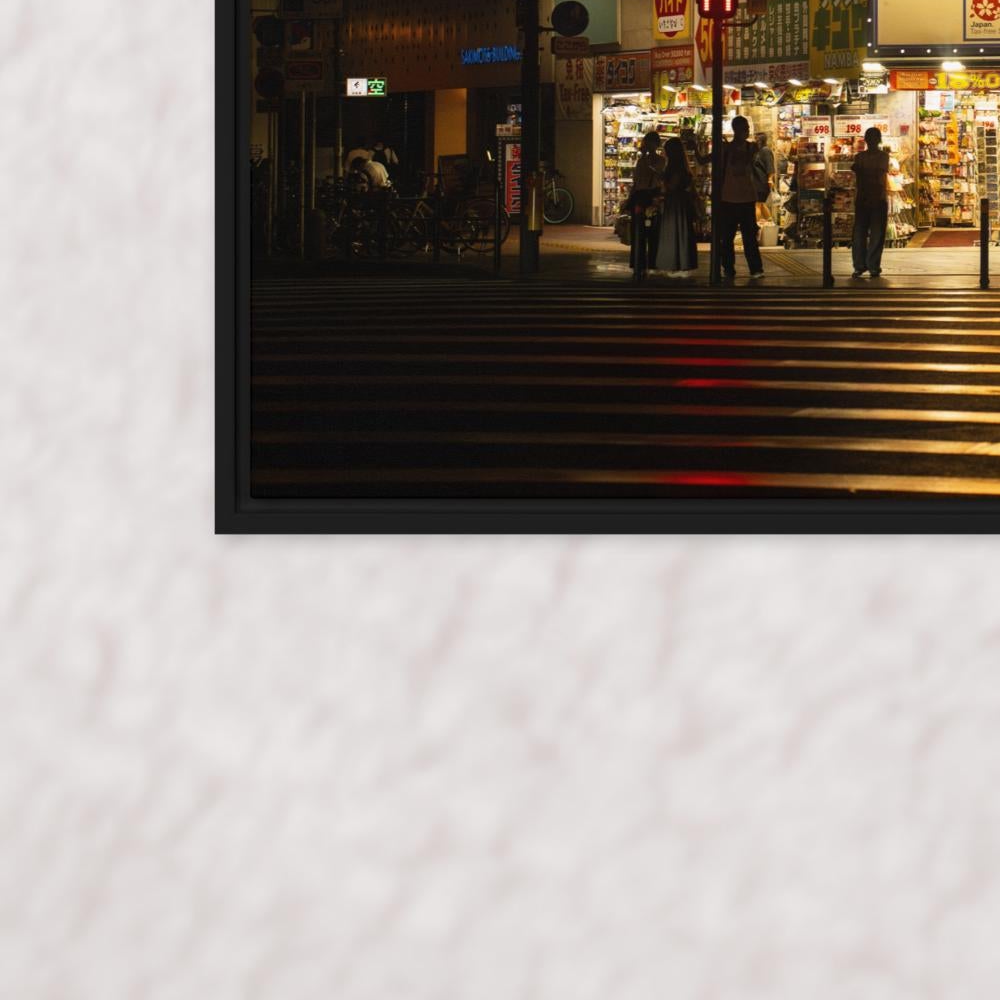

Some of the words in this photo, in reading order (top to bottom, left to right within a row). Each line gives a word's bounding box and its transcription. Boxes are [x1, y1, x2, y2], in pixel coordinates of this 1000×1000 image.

[824, 51, 859, 70] NAMBA
[368, 78, 385, 95] 空
[814, 125, 830, 134] 698
